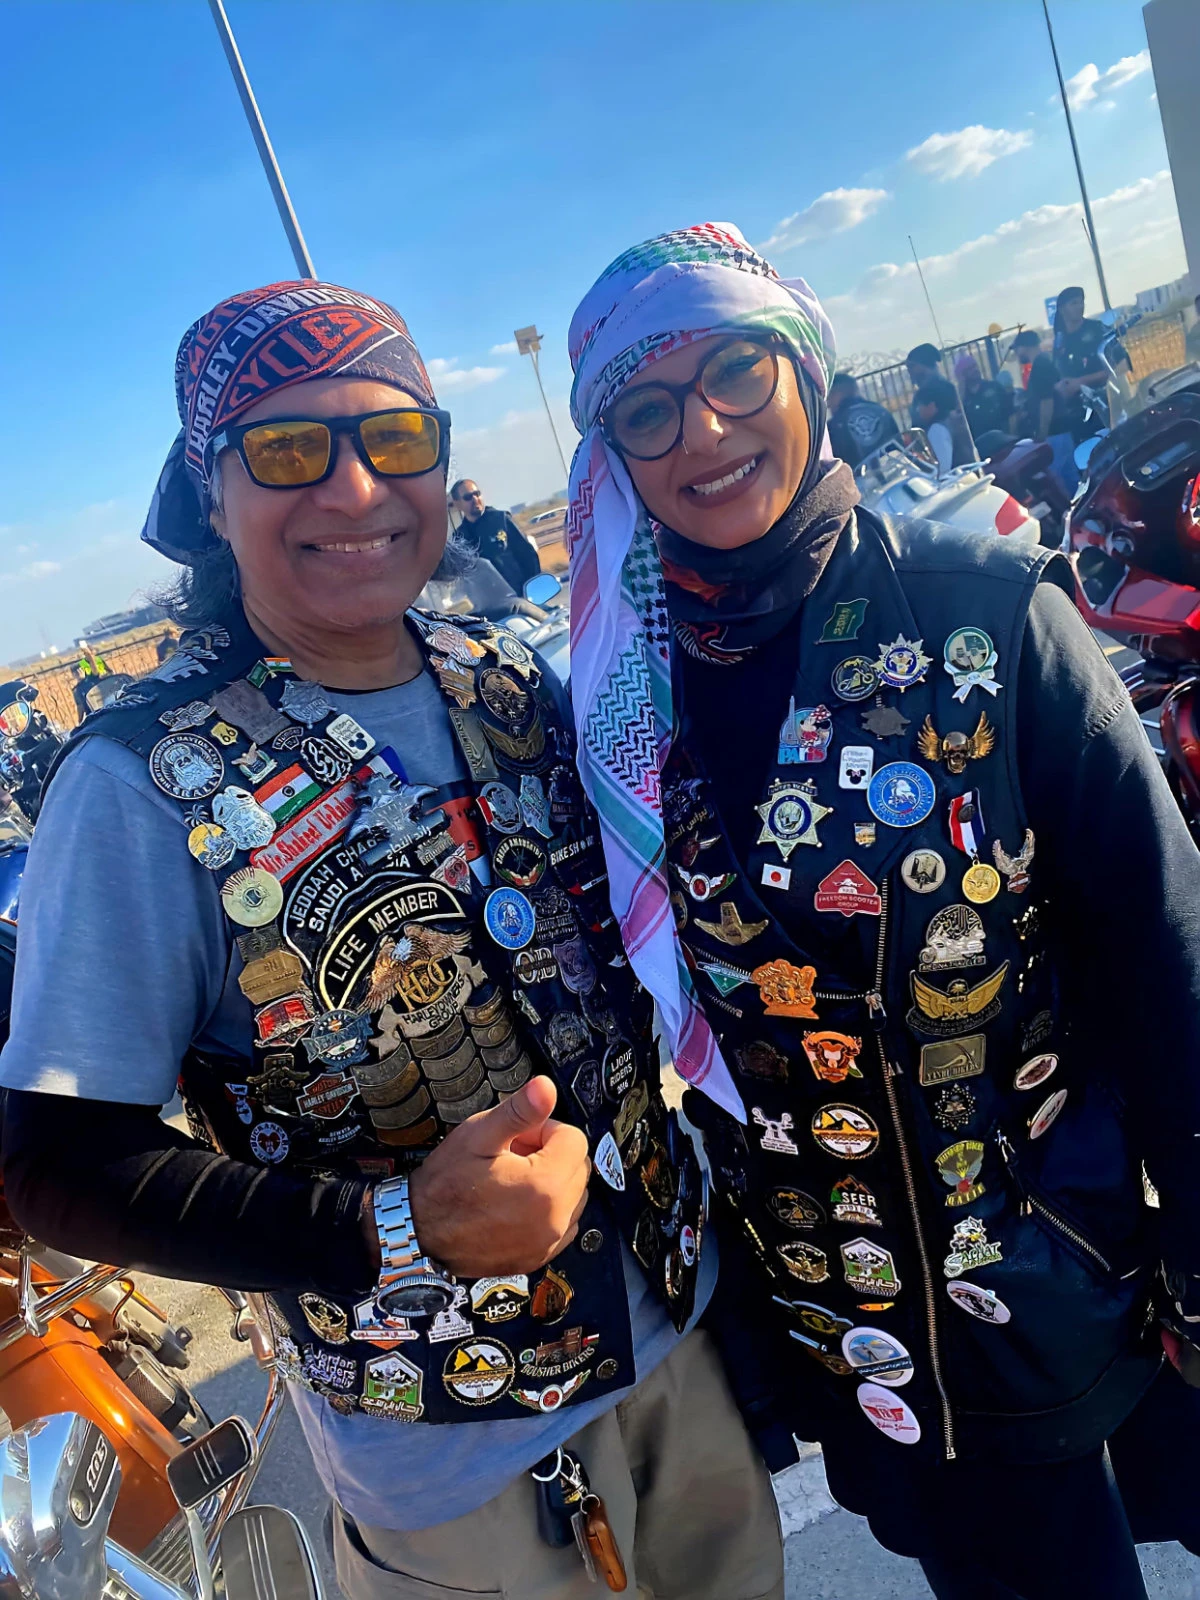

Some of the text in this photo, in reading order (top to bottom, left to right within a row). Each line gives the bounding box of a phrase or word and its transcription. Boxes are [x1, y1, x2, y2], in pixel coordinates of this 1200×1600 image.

[188, 287, 396, 455] HARLEY-DAVIDSON
[229, 311, 364, 407] CYCLES
[220, 727, 237, 743] 66
[778, 745, 827, 764] PARIS
[181, 771, 221, 798] RALLY
[289, 864, 335, 929] JEDDAH
[309, 878, 349, 932] SAUDI
[328, 935, 367, 983] LIFE
[367, 891, 439, 934] MEMBER
[402, 1003, 439, 1025] HARLEY
[428, 1000, 459, 1029] GROUP
[608, 1063, 633, 1087] RIDERS
[841, 1191, 877, 1208] SEER
[488, 1300, 517, 1318] HOG
[314, 1349, 354, 1369] Jordan
[318, 1359, 356, 1380] Riders
[520, 1364, 562, 1378] BOUSHER
[562, 1346, 596, 1373] BIKERS
